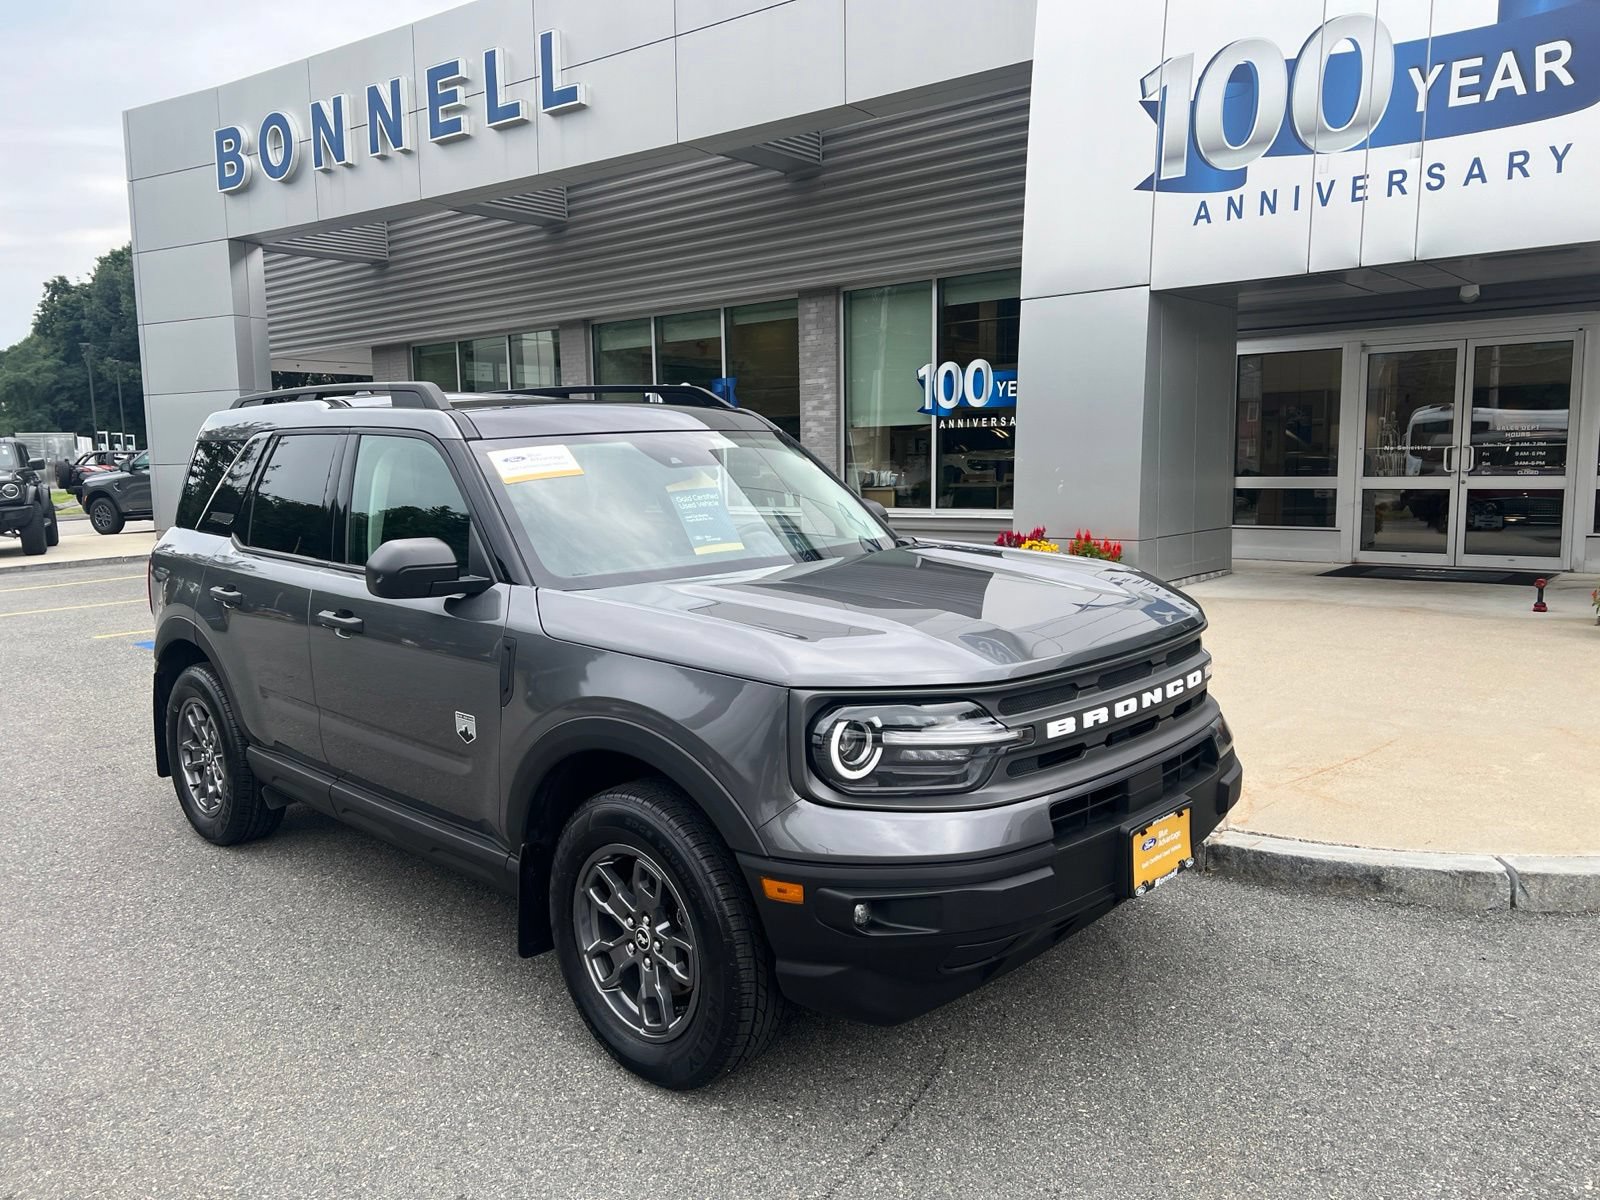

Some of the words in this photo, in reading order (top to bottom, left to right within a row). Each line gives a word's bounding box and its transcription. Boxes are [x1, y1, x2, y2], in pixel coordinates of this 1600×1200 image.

[213, 28, 589, 195] BONNELL
[1140, 12, 1395, 182] 100
[1408, 40, 1576, 113] YEAR
[1193, 142, 1575, 226] ANNIVERSARY
[917, 358, 994, 410] 100
[1046, 670, 1202, 739] BRONCO
